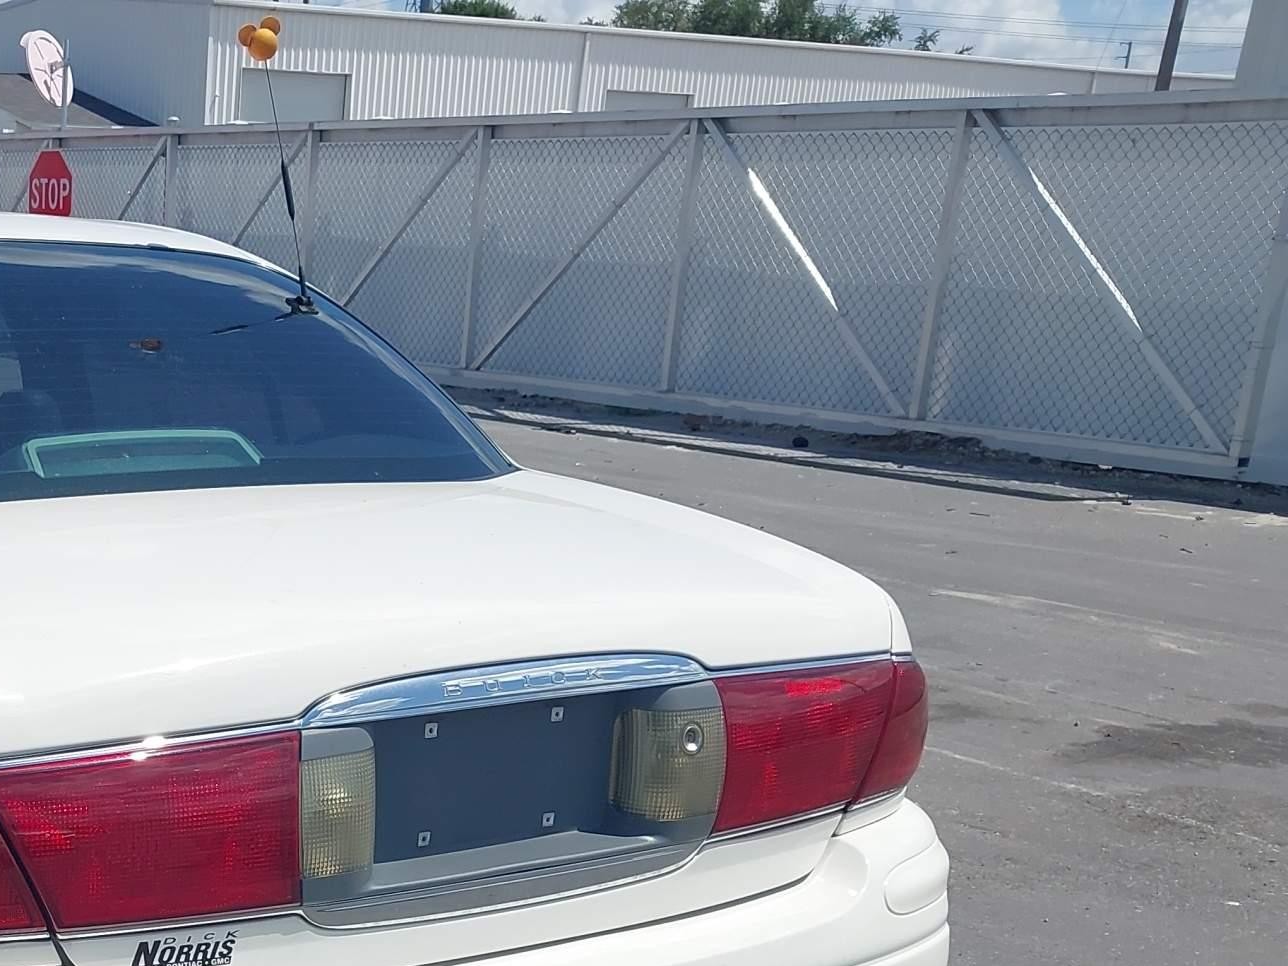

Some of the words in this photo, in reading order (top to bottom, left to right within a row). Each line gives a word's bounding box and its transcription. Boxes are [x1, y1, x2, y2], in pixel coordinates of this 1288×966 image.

[31, 178, 70, 210] STOP
[441, 667, 602, 697] BUICK
[163, 929, 241, 945] DICK
[131, 938, 236, 966] NORRIS
[210, 957, 230, 966] GMC
